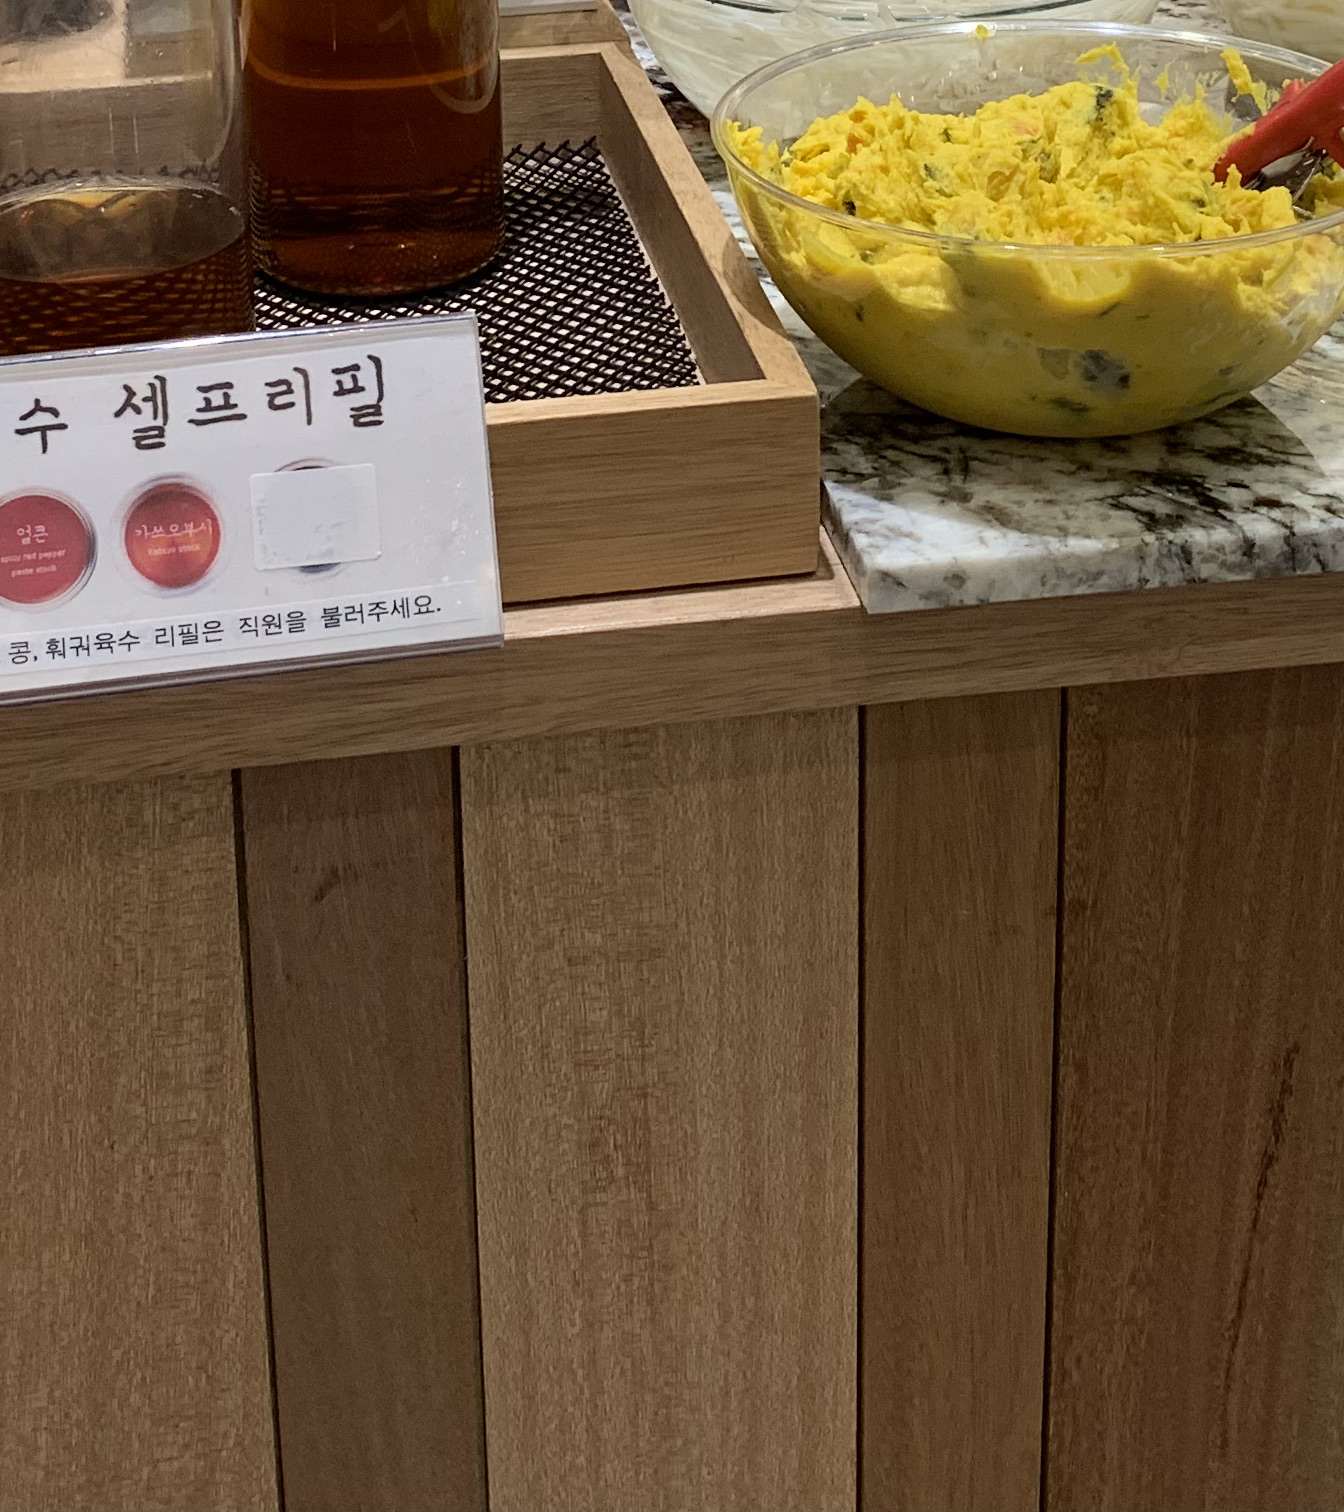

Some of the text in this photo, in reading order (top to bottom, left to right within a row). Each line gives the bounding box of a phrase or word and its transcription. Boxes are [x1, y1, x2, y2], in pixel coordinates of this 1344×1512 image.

[113, 354, 389, 452] 셀프리필
[16, 524, 49, 545] 얼큰
[134, 518, 213, 539] 가쓰오부시
[8, 638, 40, 667] 콩,
[154, 618, 226, 649] 리필은
[237, 608, 308, 638] 직원을
[319, 594, 443, 630] 불러주세요.
